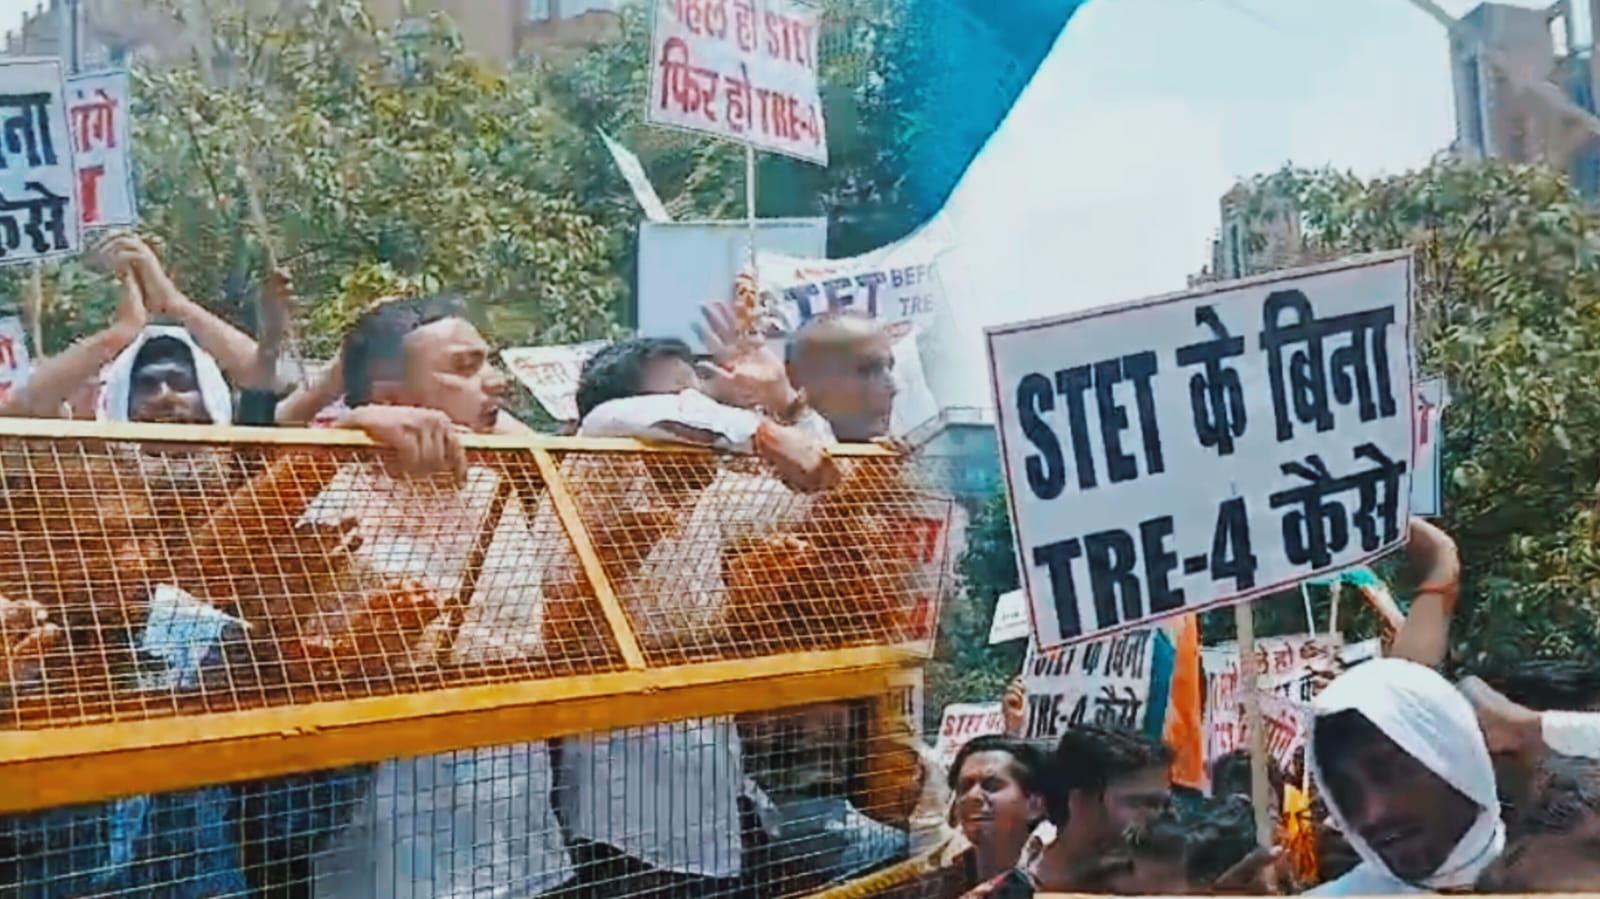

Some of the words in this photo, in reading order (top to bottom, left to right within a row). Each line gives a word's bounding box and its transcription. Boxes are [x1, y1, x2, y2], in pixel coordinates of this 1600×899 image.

[0, 93, 57, 168] ना
[660, 37, 718, 122] फिर
[725, 61, 752, 133] हो
[756, 88, 820, 146] TRE-4
[1016, 350, 1165, 500] STET
[1176, 305, 1247, 456] के
[1259, 289, 1397, 442] बिना
[1033, 496, 1258, 640] TRE-4
[1269, 442, 1406, 569] कैसे
